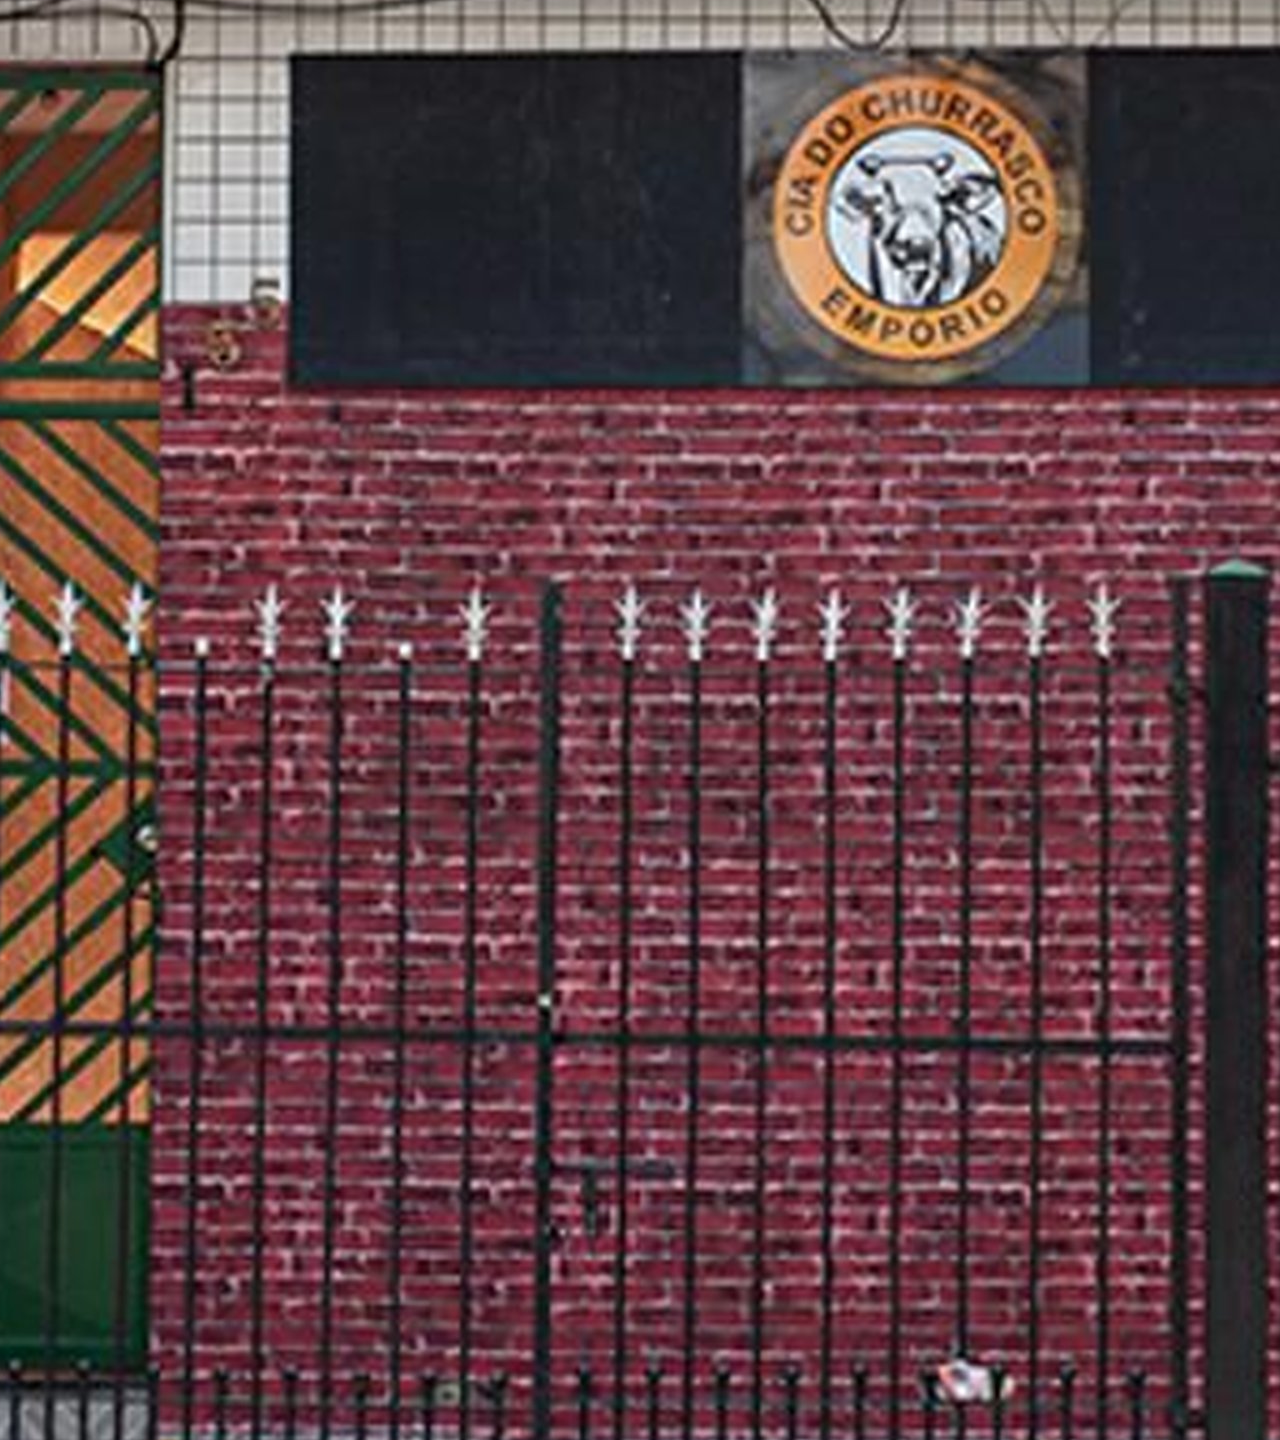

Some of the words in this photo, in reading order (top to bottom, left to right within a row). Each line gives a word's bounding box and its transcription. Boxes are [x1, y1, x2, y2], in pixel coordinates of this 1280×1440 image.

[786, 175, 816, 236] CIA
[804, 114, 854, 167] DO
[861, 88, 1047, 235] CHURRASCO
